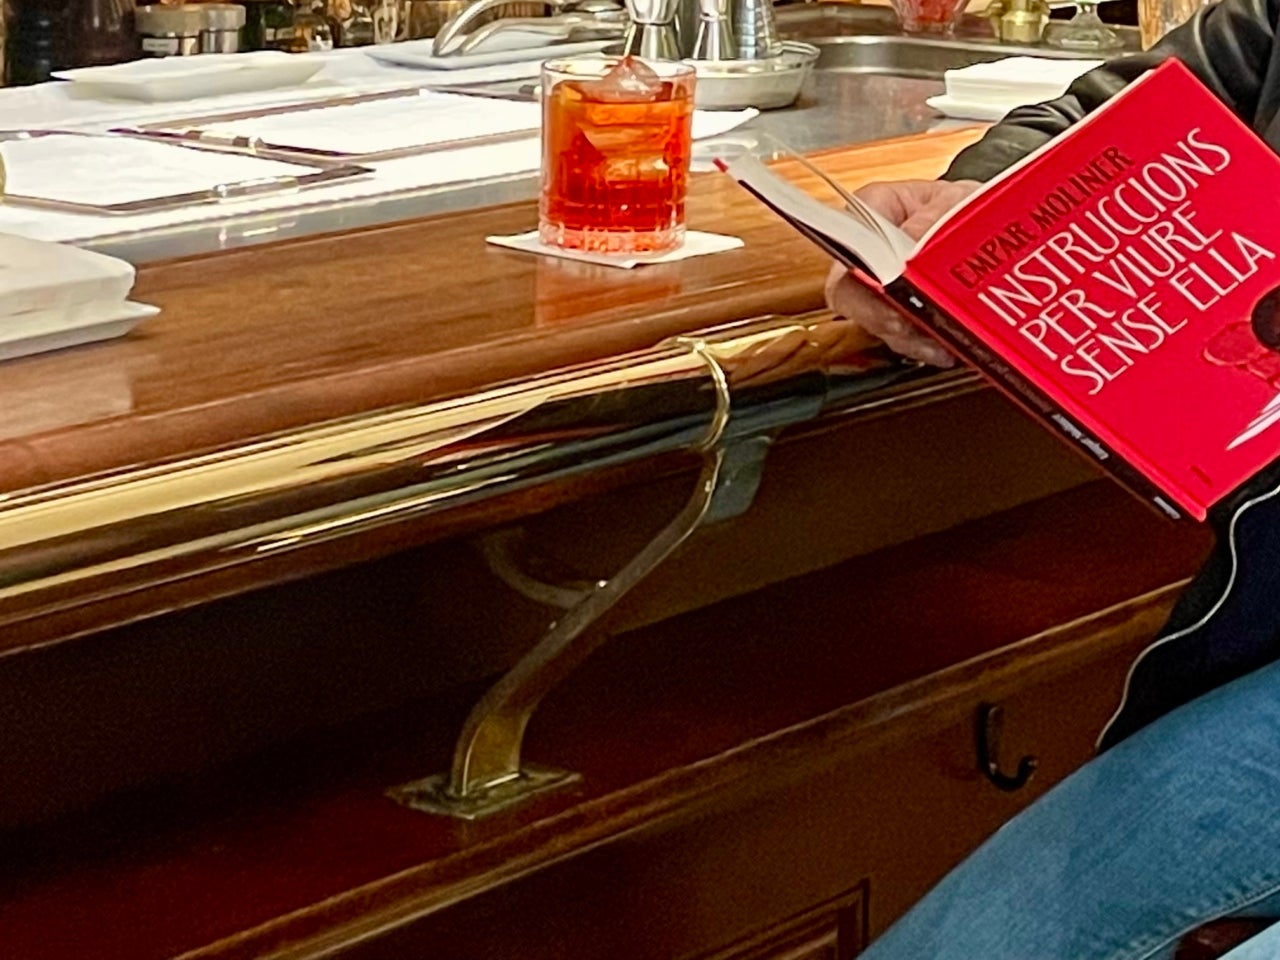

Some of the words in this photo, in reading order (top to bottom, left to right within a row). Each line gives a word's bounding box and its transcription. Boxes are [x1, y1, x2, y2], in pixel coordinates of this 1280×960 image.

[951, 221, 1033, 289] EMPAR
[1029, 146, 1136, 233] MOLINER
[977, 127, 1231, 327] INSTRUCCIONS
[1018, 289, 1116, 361] PER
[1091, 200, 1223, 299] VIURE
[1060, 292, 1188, 396] SENSE
[1168, 231, 1276, 311] ELLA
